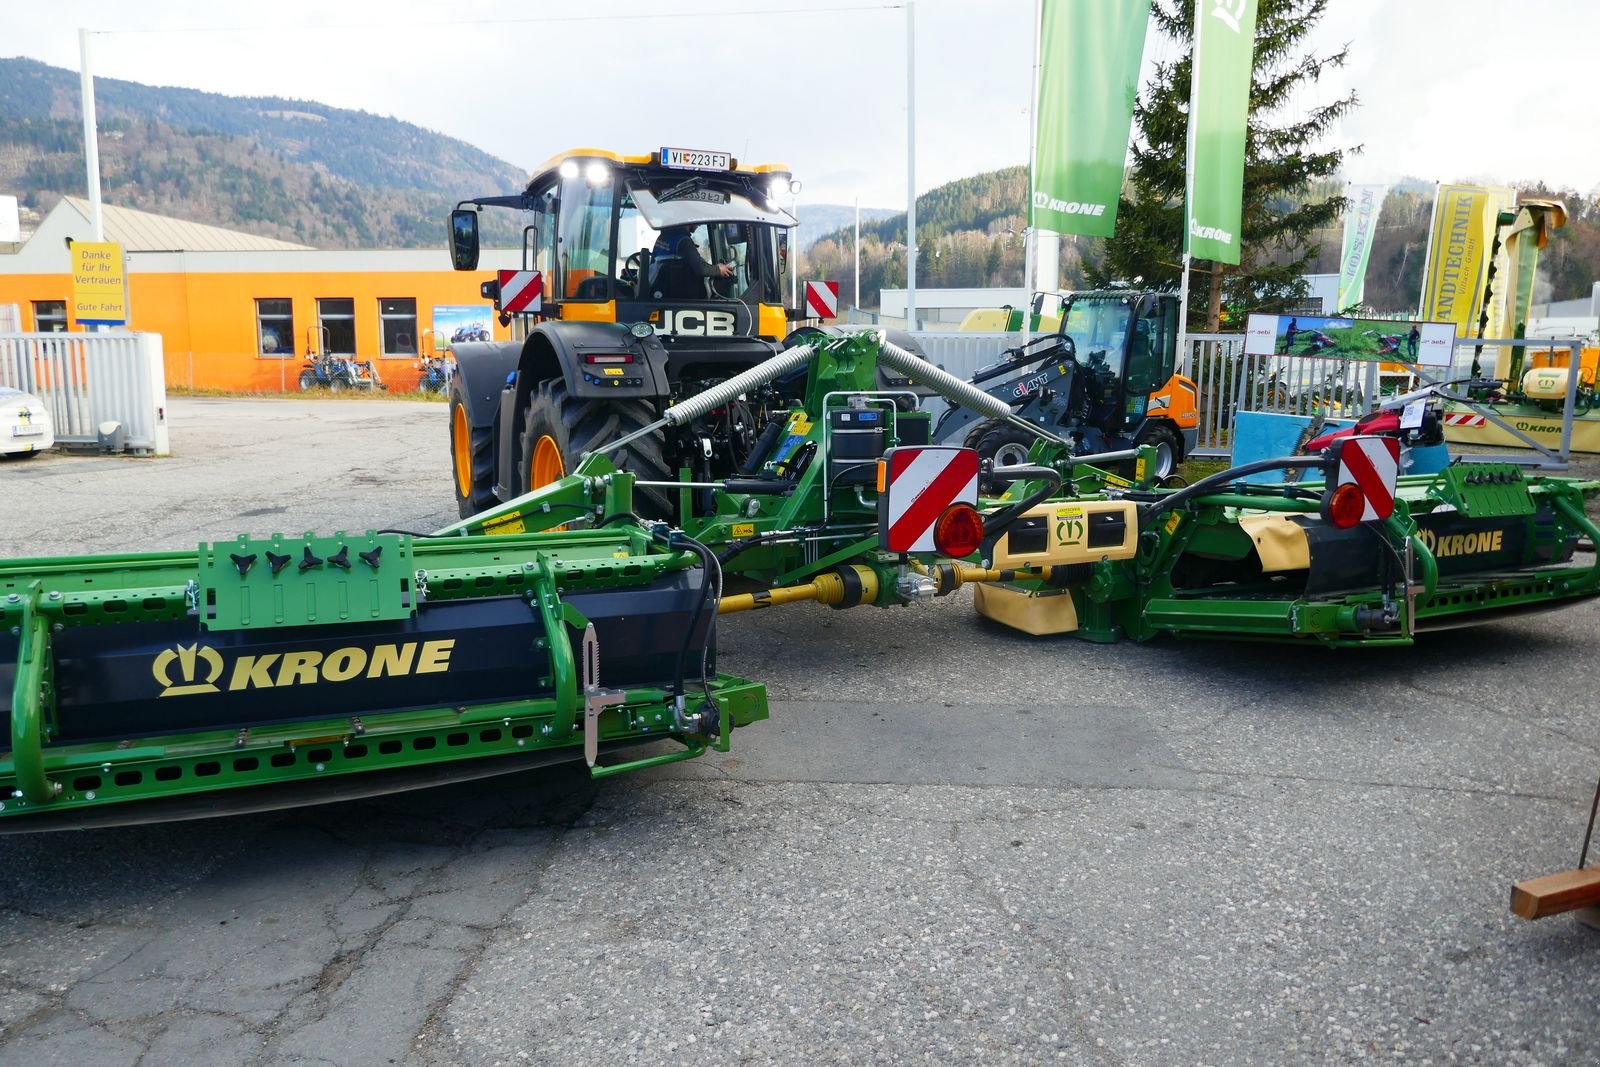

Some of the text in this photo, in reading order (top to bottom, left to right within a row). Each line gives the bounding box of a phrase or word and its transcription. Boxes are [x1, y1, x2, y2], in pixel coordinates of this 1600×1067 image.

[672, 151, 682, 164] VI
[1048, 198, 1106, 216] KRONE
[1197, 225, 1232, 245] KRONE
[81, 250, 111, 259] Danke
[1437, 195, 1473, 320] ANDTECHNIK
[82, 262, 111, 272] für Ihr
[1458, 238, 1476, 295] Villach GmbH
[75, 275, 121, 285] Vertrauen
[76, 303, 122, 312] Gute Fahrt
[650, 310, 735, 336] JCB
[1529, 424, 1562, 433] KRON
[1436, 530, 1503, 557] KRONE
[229, 639, 456, 691] KRONE
